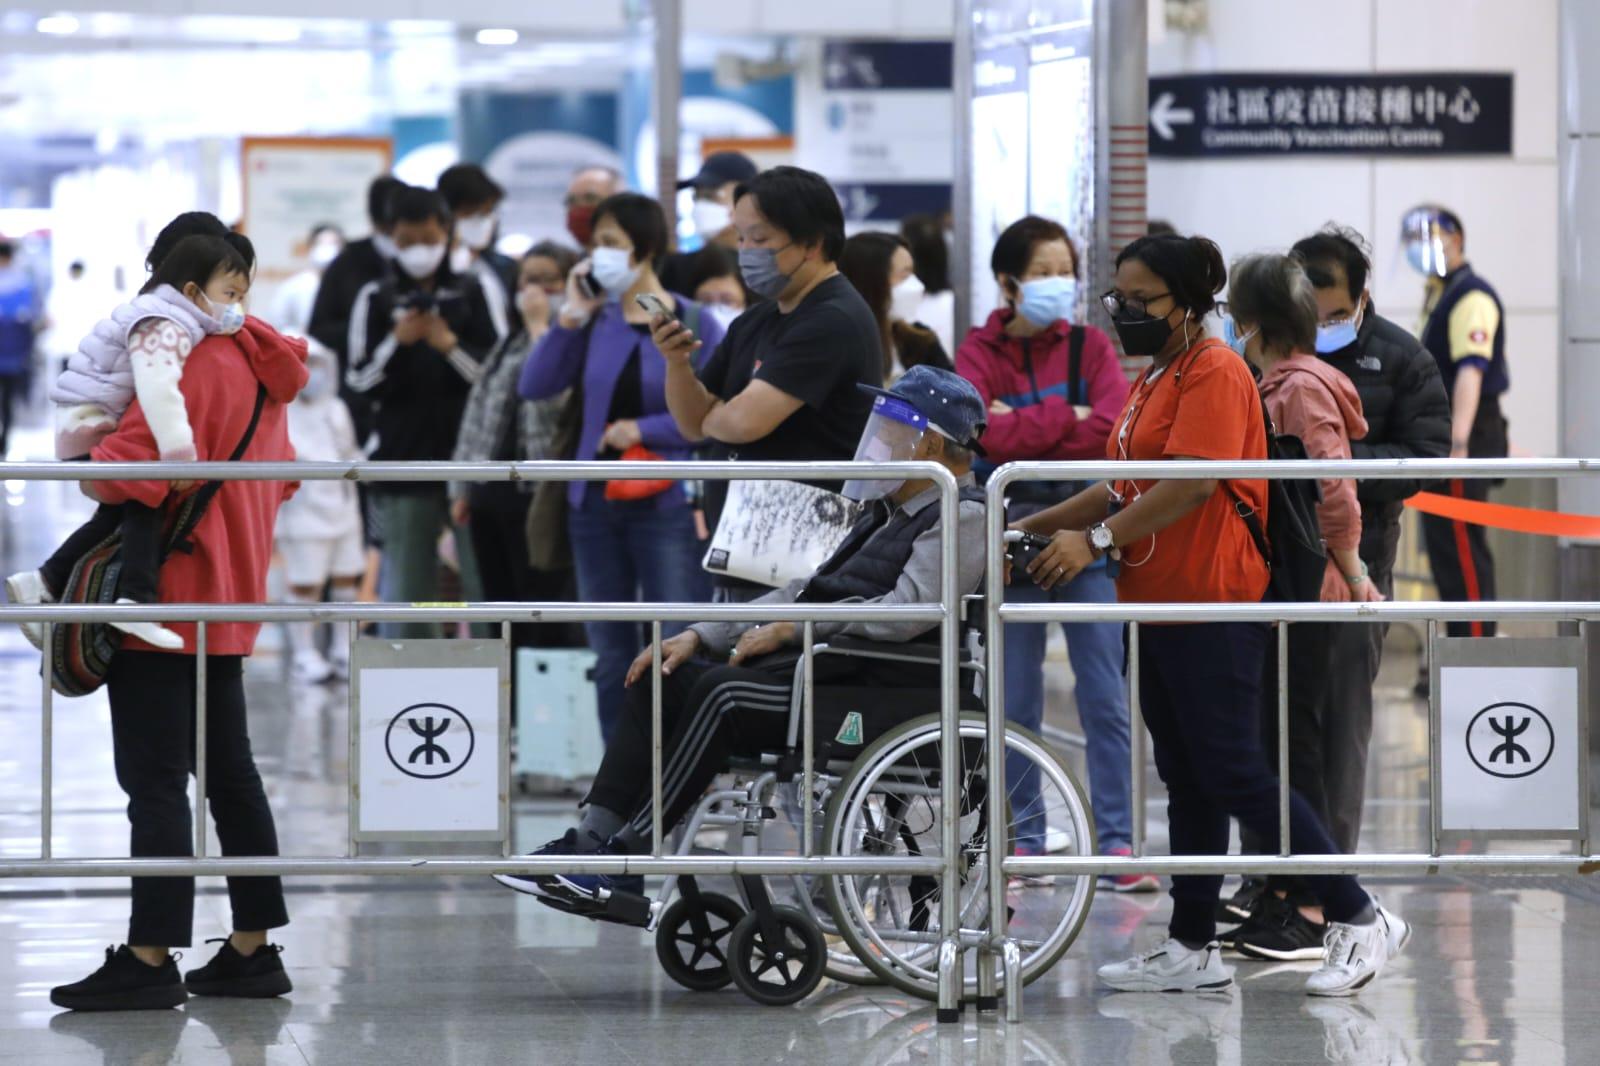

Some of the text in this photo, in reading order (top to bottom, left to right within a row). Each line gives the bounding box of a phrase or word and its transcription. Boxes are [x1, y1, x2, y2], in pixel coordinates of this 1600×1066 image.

[1205, 86, 1480, 124] 社區疫苗接種中心
[1203, 127, 1443, 148] Community Vaccination Centre
